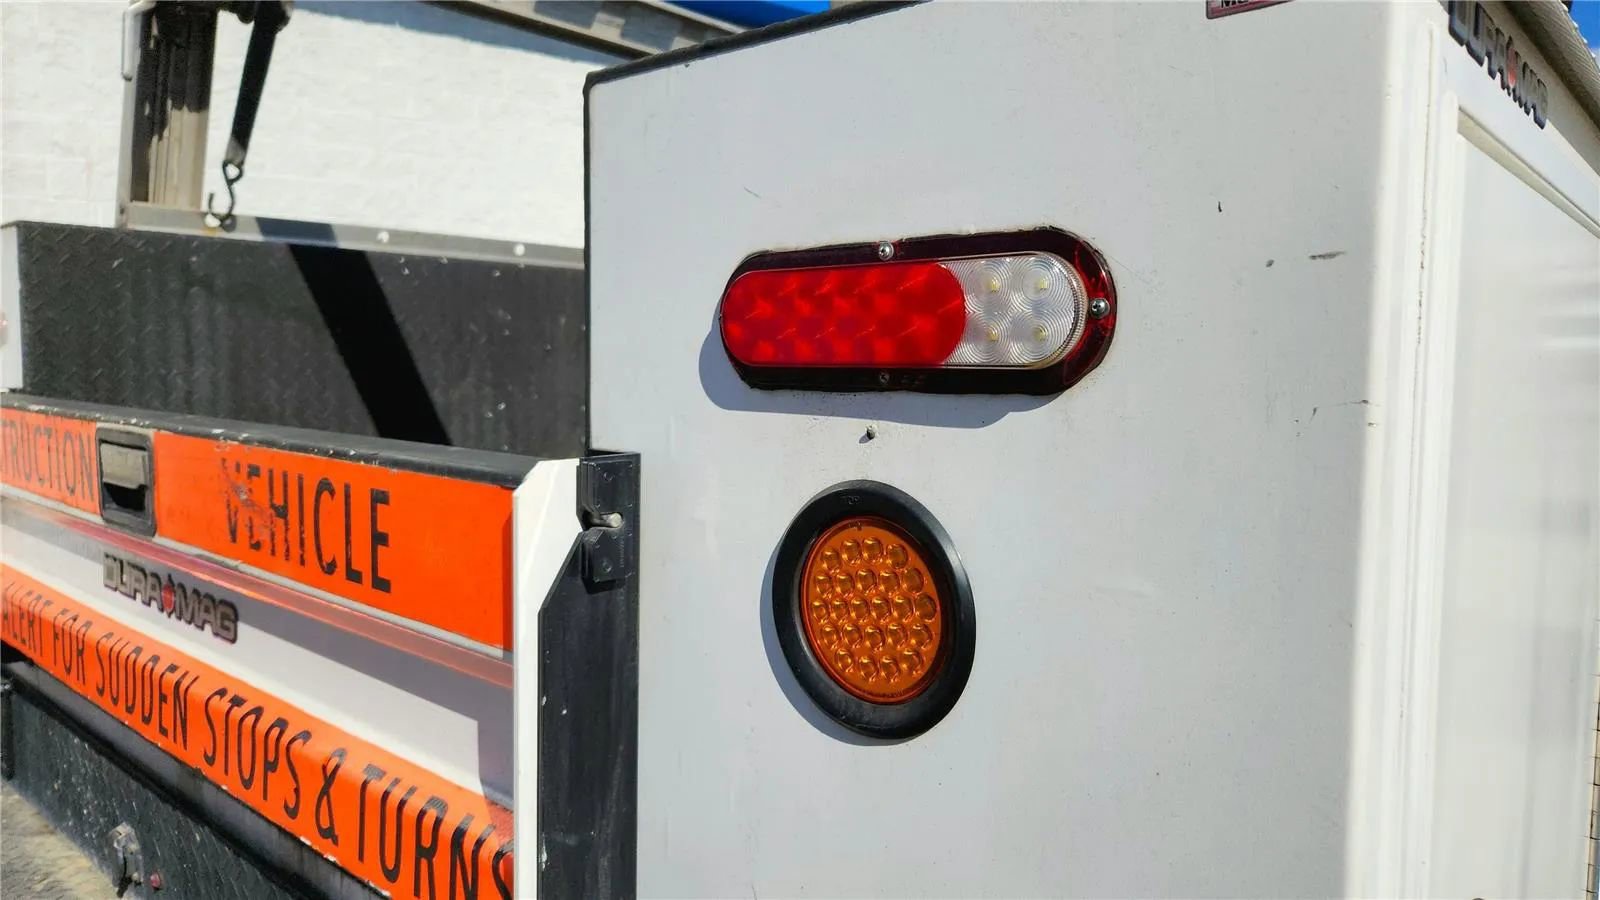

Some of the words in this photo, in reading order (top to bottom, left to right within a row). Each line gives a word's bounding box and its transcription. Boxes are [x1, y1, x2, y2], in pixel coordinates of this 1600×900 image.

[220, 457, 392, 593] VEHICLE
[1, 582, 54, 657] ALERT
[53, 608, 93, 686] FOR
[95, 630, 199, 751] SUDDEN
[203, 687, 312, 820] STOPS
[315, 748, 348, 847] &
